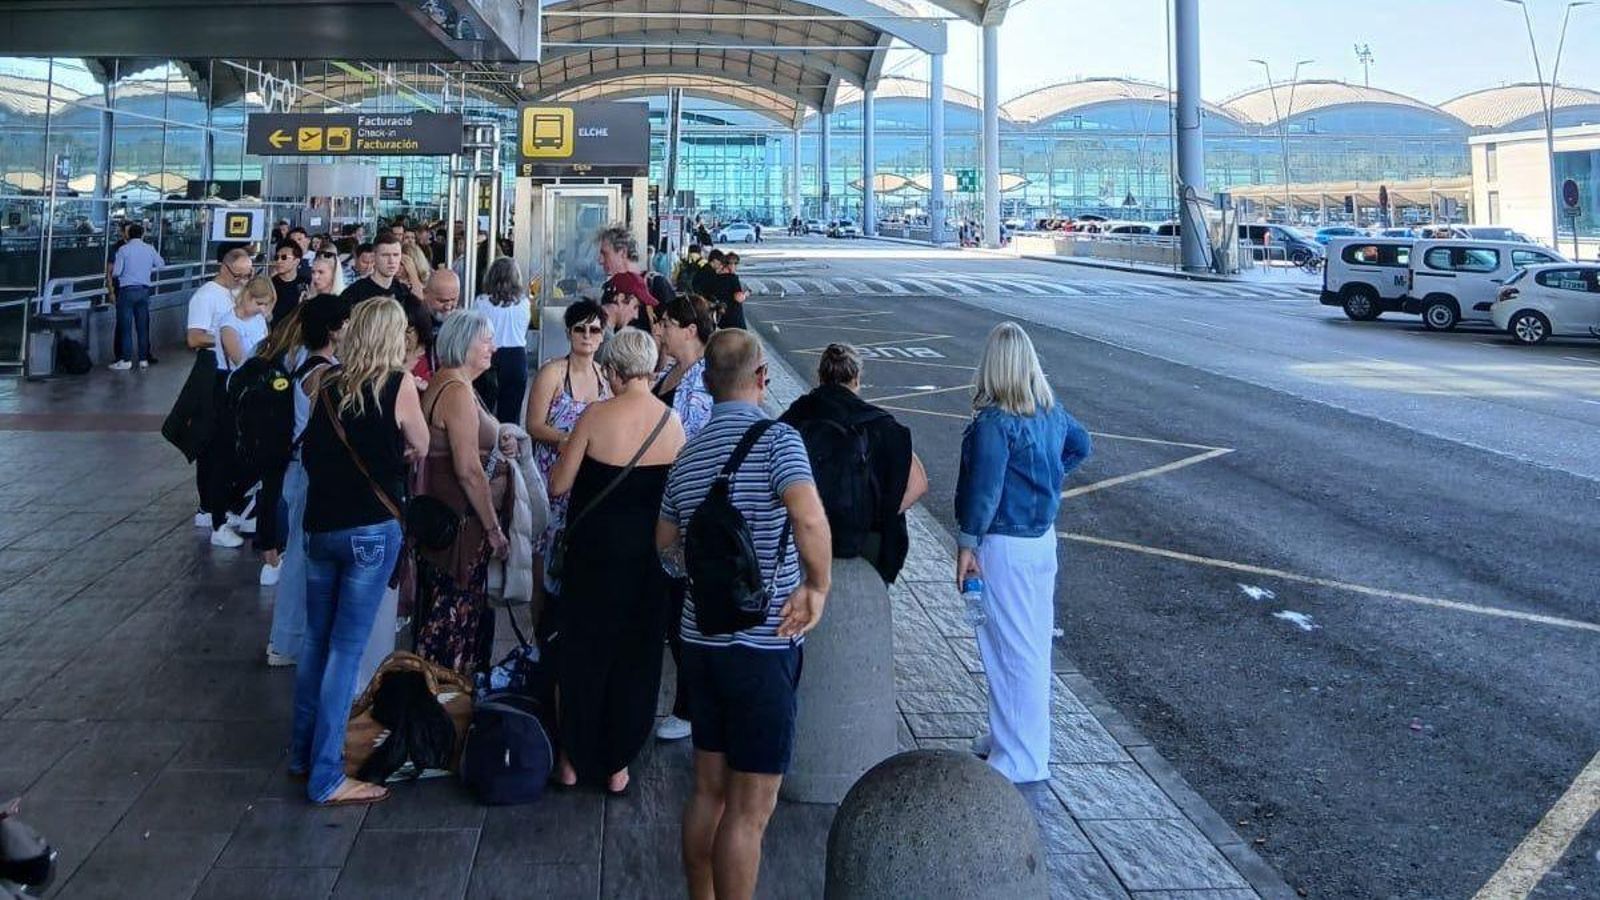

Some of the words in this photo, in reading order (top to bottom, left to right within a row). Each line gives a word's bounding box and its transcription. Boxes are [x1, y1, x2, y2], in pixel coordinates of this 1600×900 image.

[358, 115, 413, 126] Facturació
[357, 128, 397, 138] Check-in
[578, 127, 609, 137] ELCHE
[356, 138, 419, 150] Facturación
